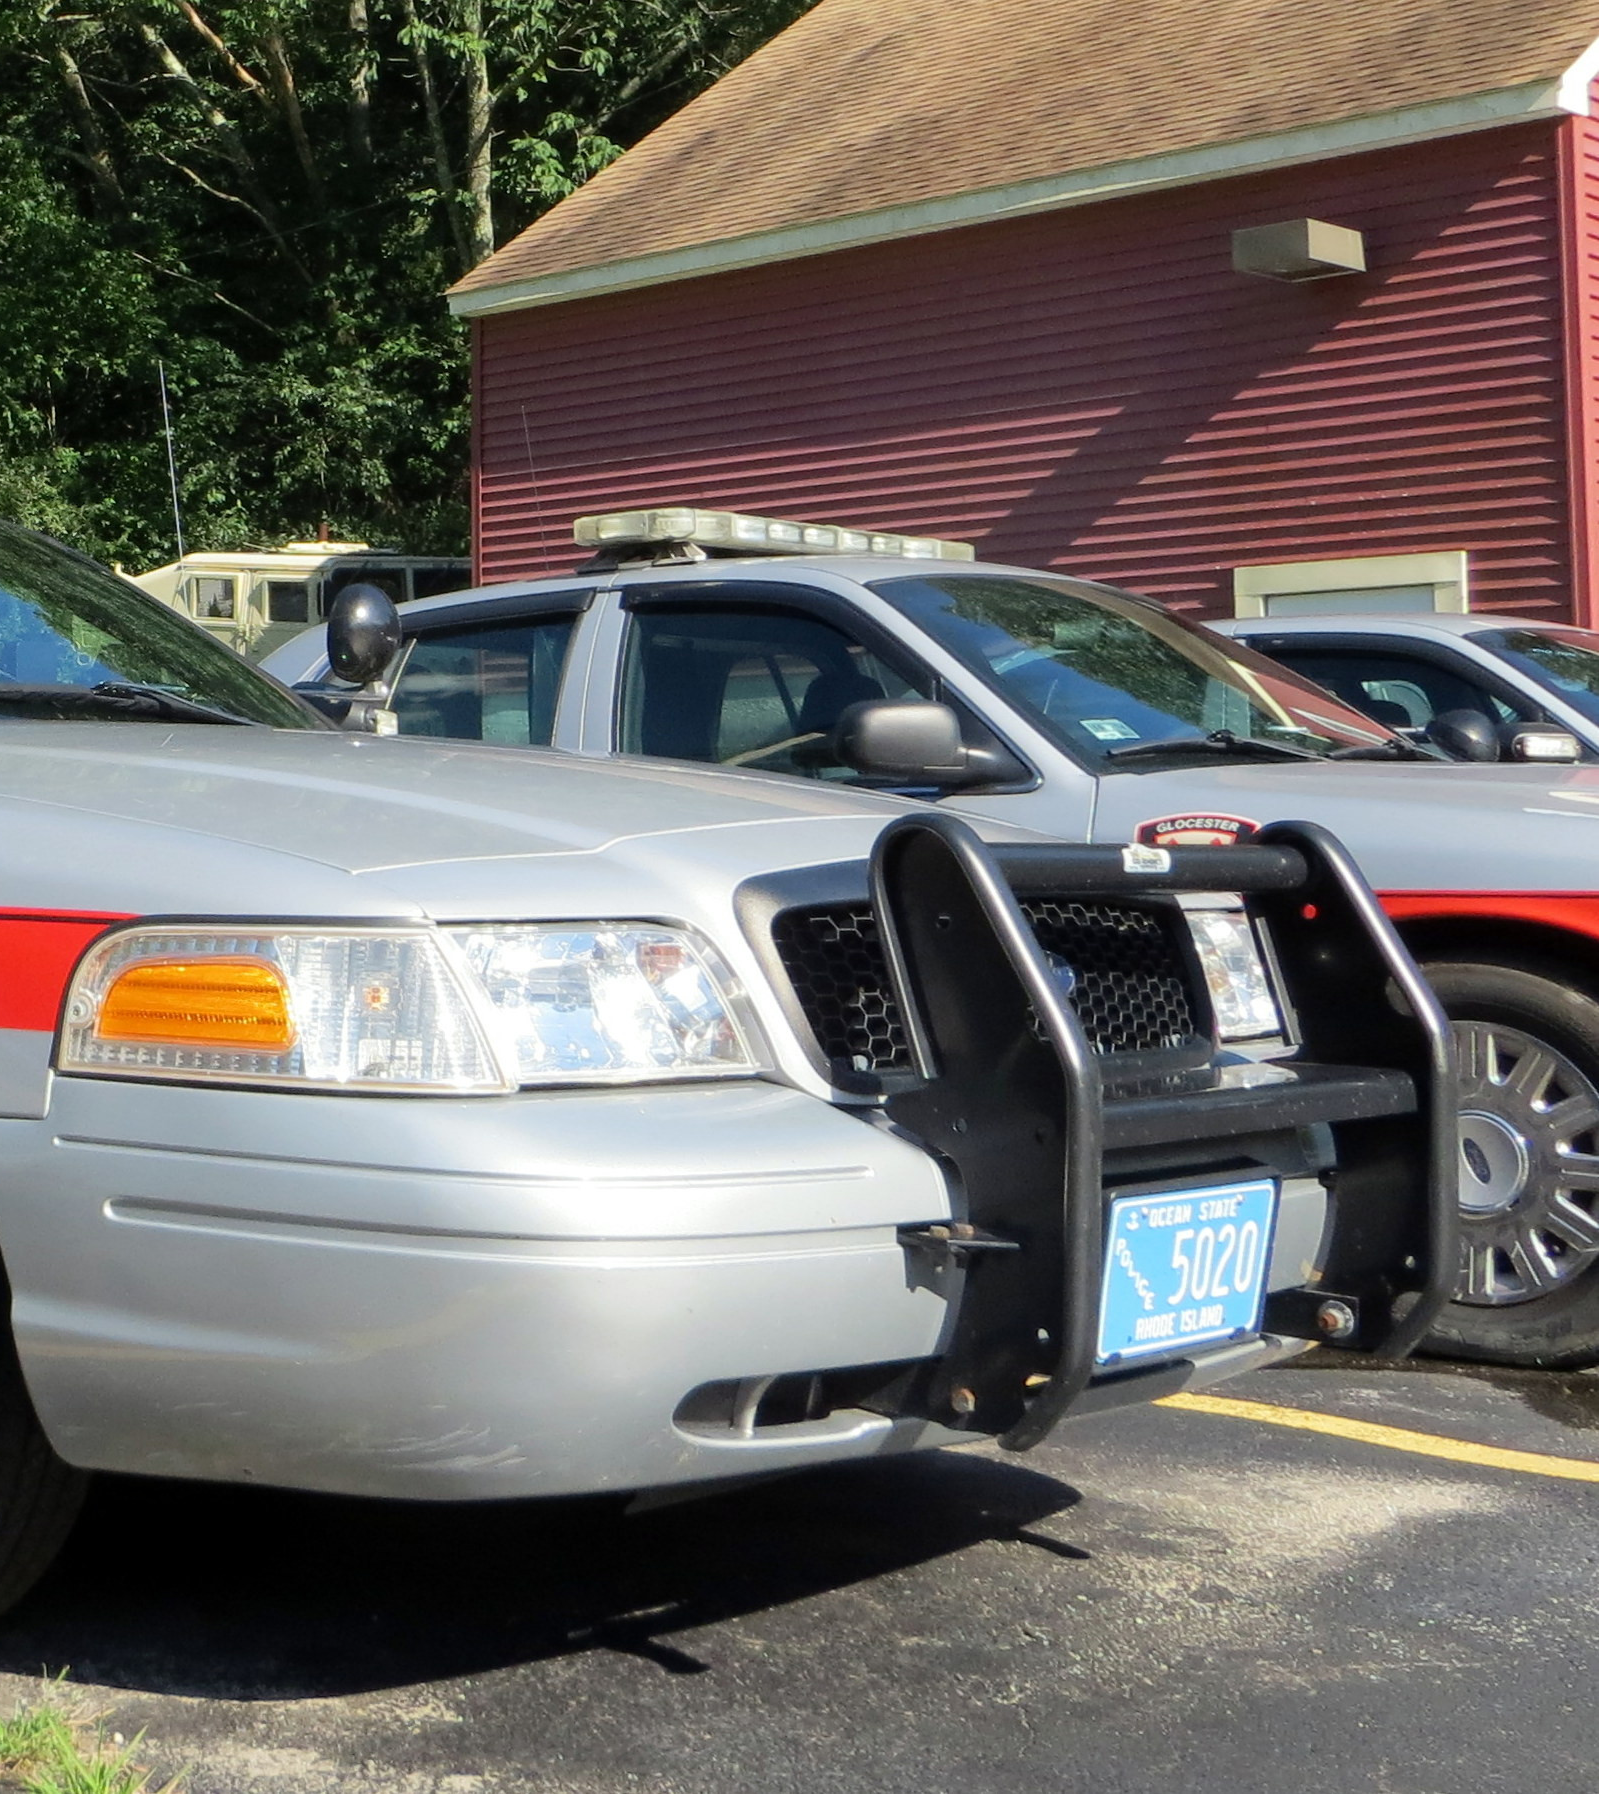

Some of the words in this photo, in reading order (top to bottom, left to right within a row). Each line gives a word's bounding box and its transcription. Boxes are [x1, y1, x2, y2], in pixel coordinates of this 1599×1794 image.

[1155, 818, 1241, 833] GLOCESTER
[1148, 1204, 1192, 1228] OCEAN
[1198, 1198, 1238, 1221] STATE
[1115, 1237, 1156, 1310] POLICE
[1167, 1220, 1258, 1305] 5020
[1135, 1312, 1177, 1341] RHODE
[1180, 1303, 1224, 1333] ISLAND
